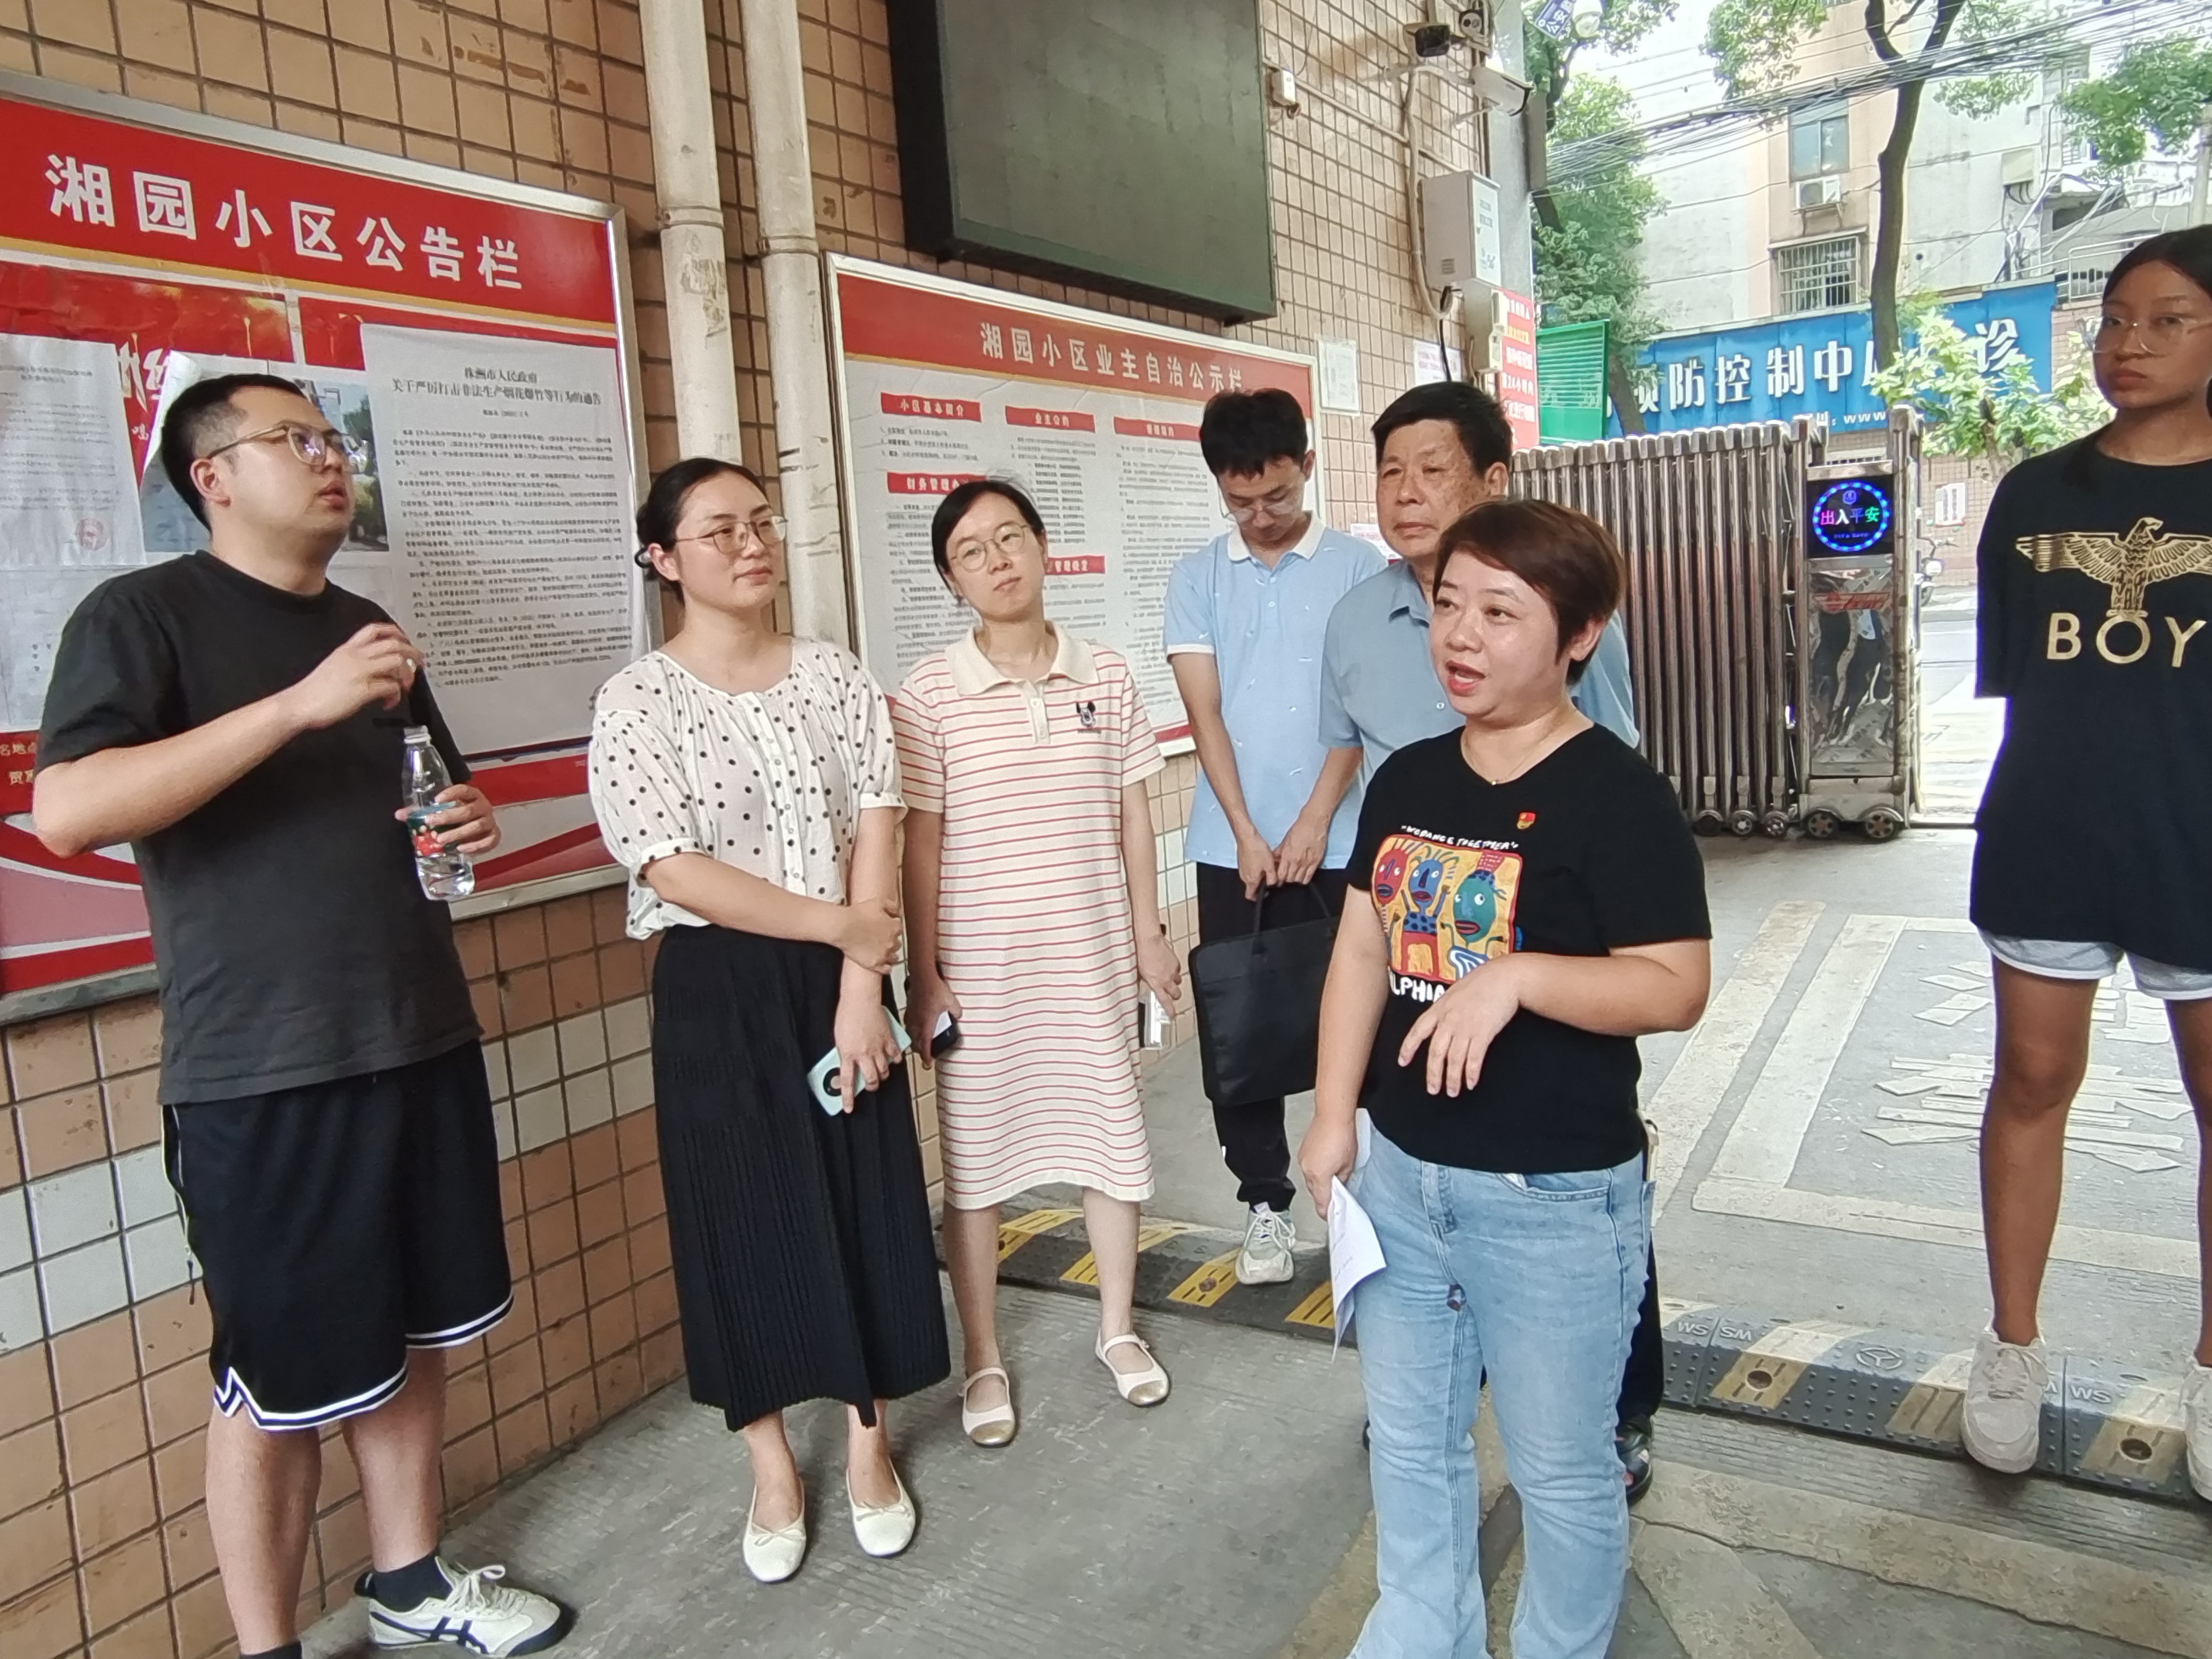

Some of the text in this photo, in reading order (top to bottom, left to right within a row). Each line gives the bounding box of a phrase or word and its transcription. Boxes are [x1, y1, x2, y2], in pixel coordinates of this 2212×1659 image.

[45, 154, 522, 290] 湘园小区公告栏
[979, 322, 1242, 392] 湘园小区业主自治公示栏
[1820, 506, 1880, 525] 出入平安
[2047, 612, 2207, 667] BOY
[1387, 965, 1445, 1003] LPHIA
